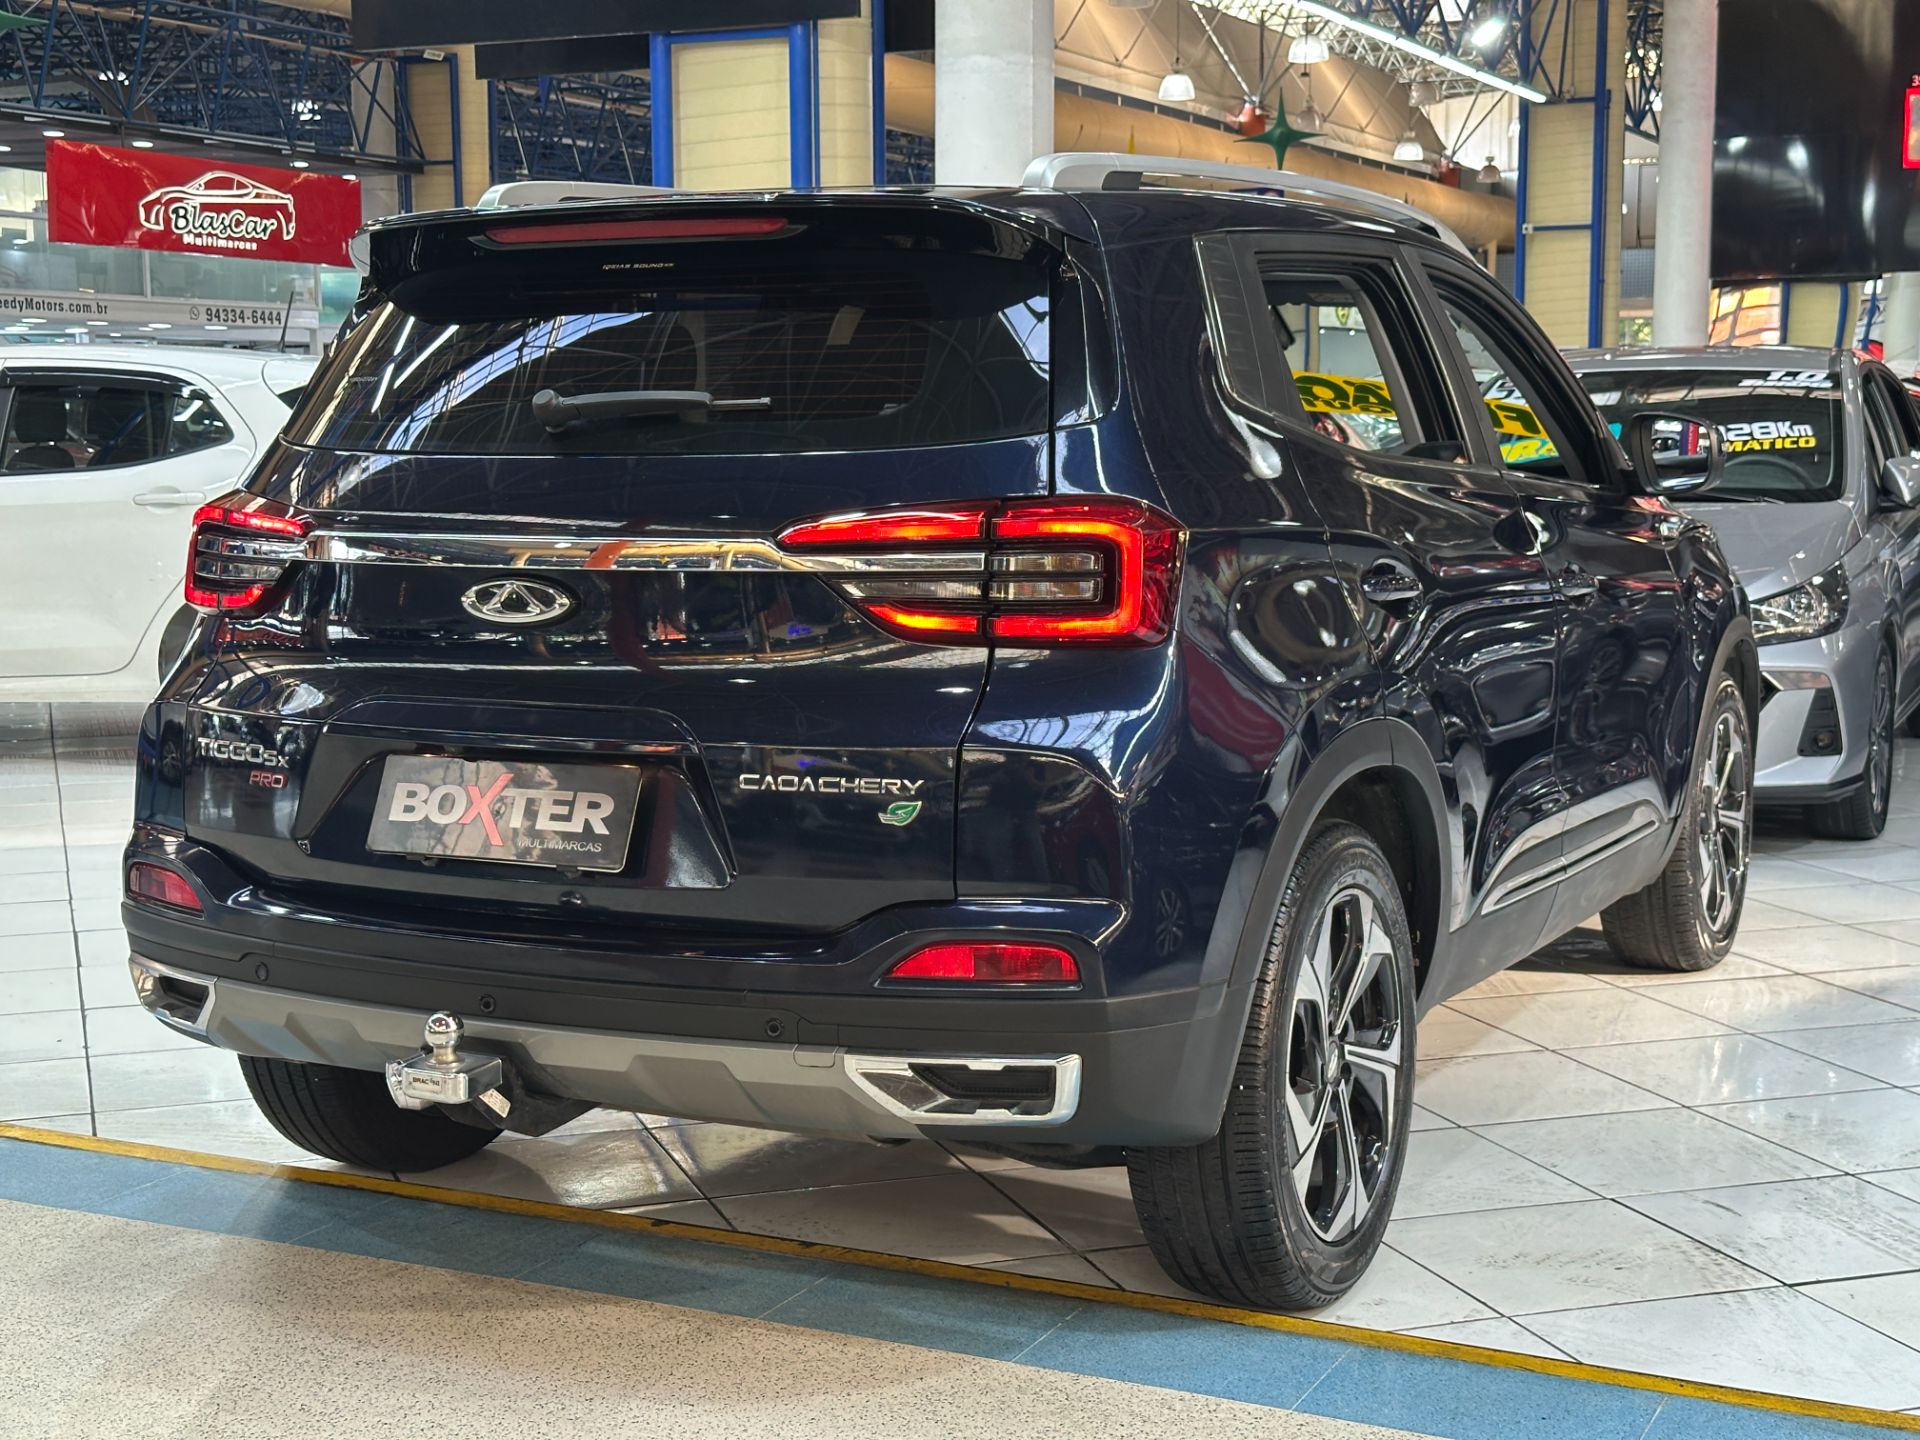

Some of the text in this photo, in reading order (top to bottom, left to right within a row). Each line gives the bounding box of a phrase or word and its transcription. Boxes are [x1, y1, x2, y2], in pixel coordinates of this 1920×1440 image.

[169, 202, 278, 240] BlasCar
[183, 233, 258, 251] Multimarcas
[205, 307, 282, 325] 94334-6444
[248, 770, 288, 789] PRO
[388, 773, 615, 847] BOXTER
[518, 838, 602, 853] MULTIMARCAS
